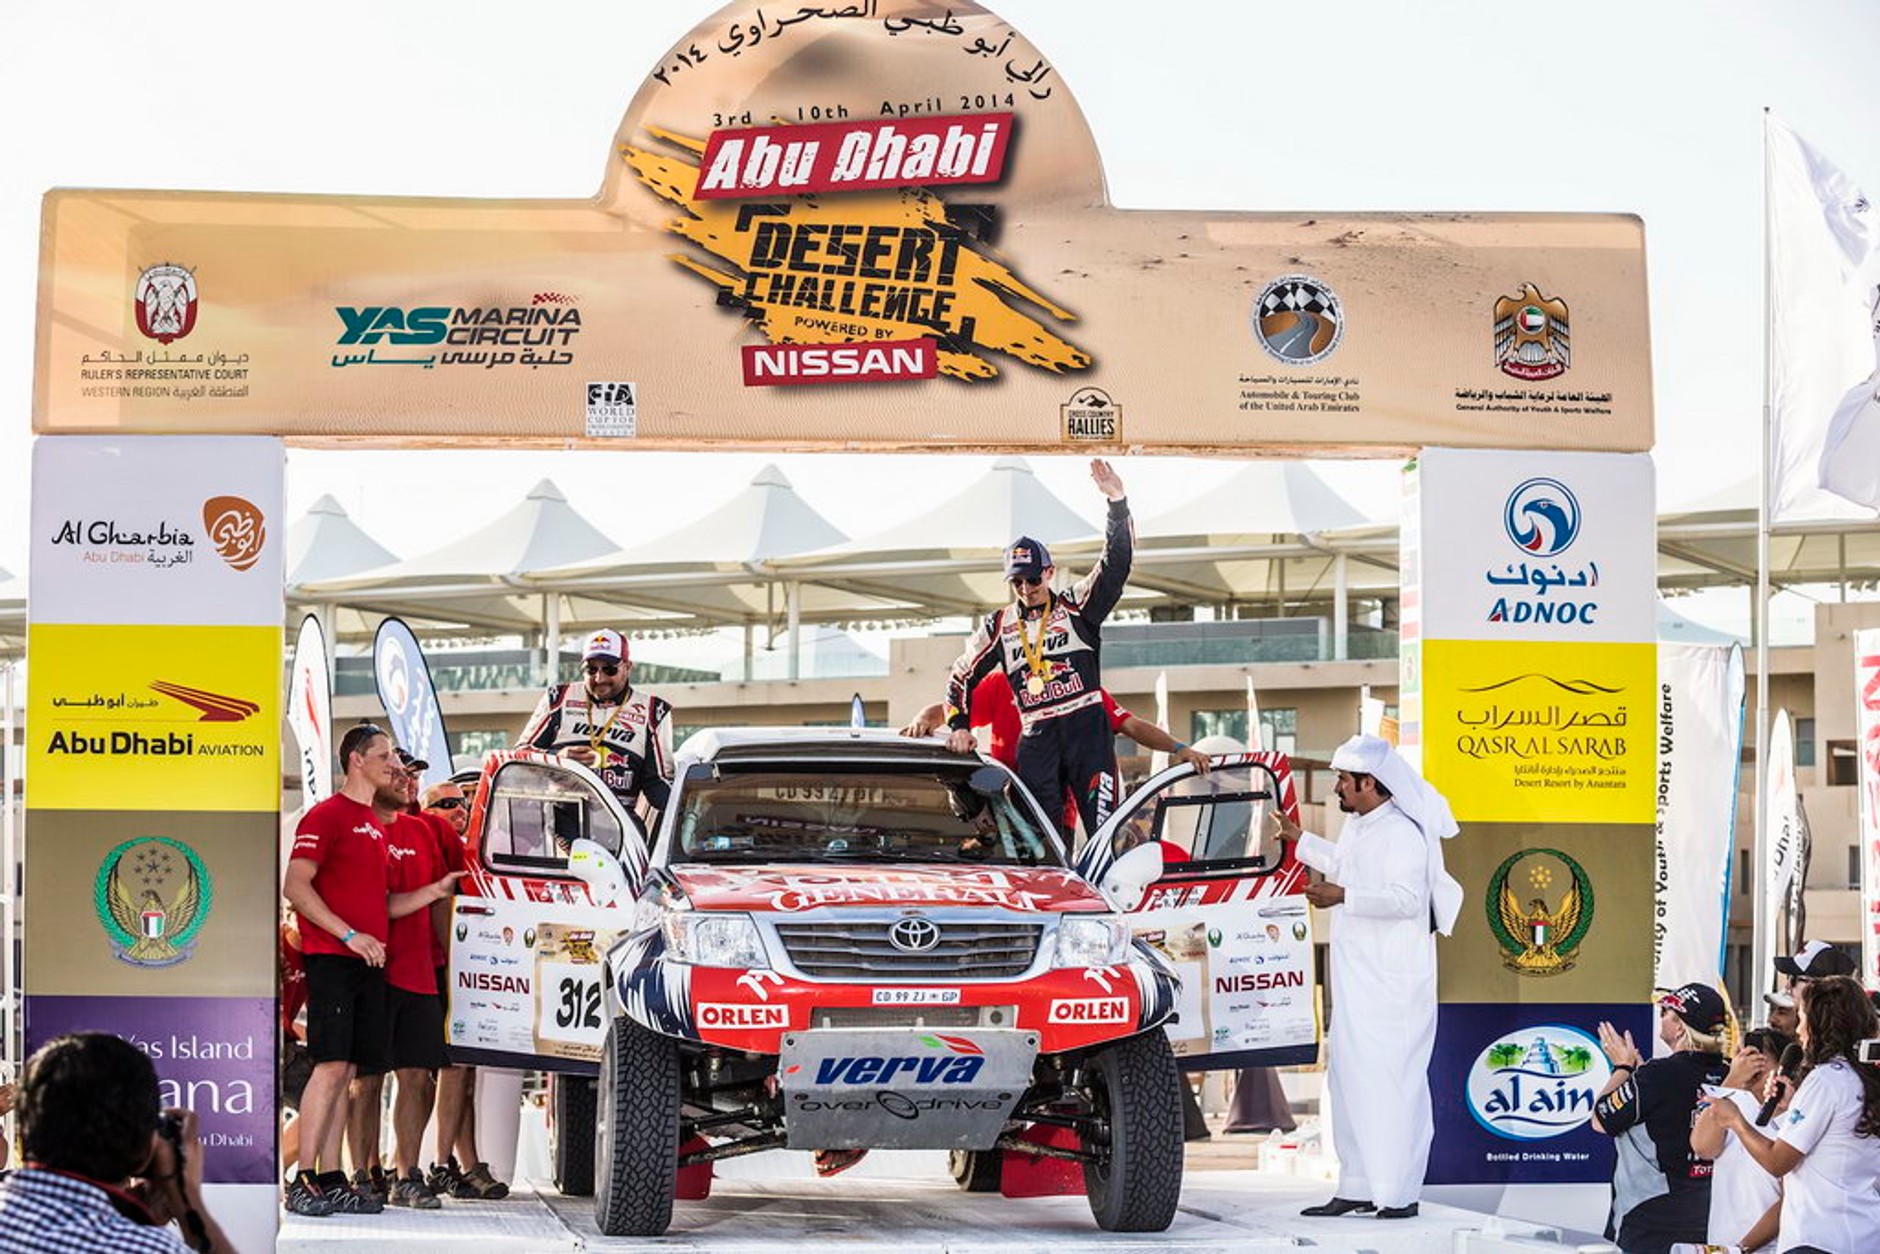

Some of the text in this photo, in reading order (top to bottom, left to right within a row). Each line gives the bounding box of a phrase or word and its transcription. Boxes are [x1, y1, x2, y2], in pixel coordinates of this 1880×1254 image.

[718, 0, 877, 57] الصحراوي
[884, 9, 964, 36] ظبي
[963, 31, 1016, 58] أبو
[1005, 60, 1051, 99] رالي
[713, 110, 751, 127] 3rd
[798, 105, 848, 120] 10th
[880, 96, 943, 118] April
[960, 93, 1014, 110] 2014
[702, 123, 998, 190] Abu Dhabi
[749, 221, 963, 286] DESERT
[743, 272, 957, 332] CHALLENGE
[335, 307, 452, 345] YAS
[451, 308, 581, 326] MARINA
[795, 316, 894, 339] POWERED BY
[447, 328, 579, 346] CIRCUIT
[331, 349, 436, 369] ياس
[520, 348, 574, 369] حلبة
[754, 349, 923, 376] NISSAN
[81, 369, 249, 380] RULER'S REPRESENTATIVE COURT
[82, 387, 170, 398] WESTERN REGION
[1240, 391, 1360, 401] Automobile & Touring Club
[1239, 401, 1360, 412] of the United Arab Emirates
[1486, 404, 1520, 413] Authority
[1531, 405, 1552, 413] Youth
[1561, 406, 1581, 414] Sports
[1068, 419, 1114, 435] RALLIES
[52, 520, 194, 545] Al Gharbia
[83, 551, 144, 563] Abu Dhabi
[147, 549, 193, 568] الغربية
[1488, 598, 1598, 624] ADNOC
[1051, 672, 1084, 699] Bull
[1457, 705, 1627, 731] قصر السراب
[1660, 683, 1674, 754] Welfare
[48, 731, 264, 756] Abu Dhabi AVIATION
[1457, 735, 1627, 760] QASR AL SARAB
[603, 769, 632, 789] Bull
[1514, 778, 1627, 790] Desert Resort by Anantara
[459, 972, 530, 994] NISSAN
[1216, 970, 1304, 994] NISSAN
[556, 977, 600, 1029] 312
[876, 991, 891, 1002] CD
[895, 991, 909, 1002] 99
[941, 991, 958, 1002] GP
[702, 1007, 782, 1025] ORLEN
[1055, 1001, 1124, 1020] ORLEN
[172, 1035, 253, 1059] Island
[815, 1055, 985, 1085] verva
[800, 1094, 1001, 1112] over drive
[1485, 1074, 1520, 1113] al
[1529, 1080, 1594, 1113] ain
[210, 1132, 253, 1146] Dhabi
[1486, 1153, 1590, 1162] Bottled Drinking Water
